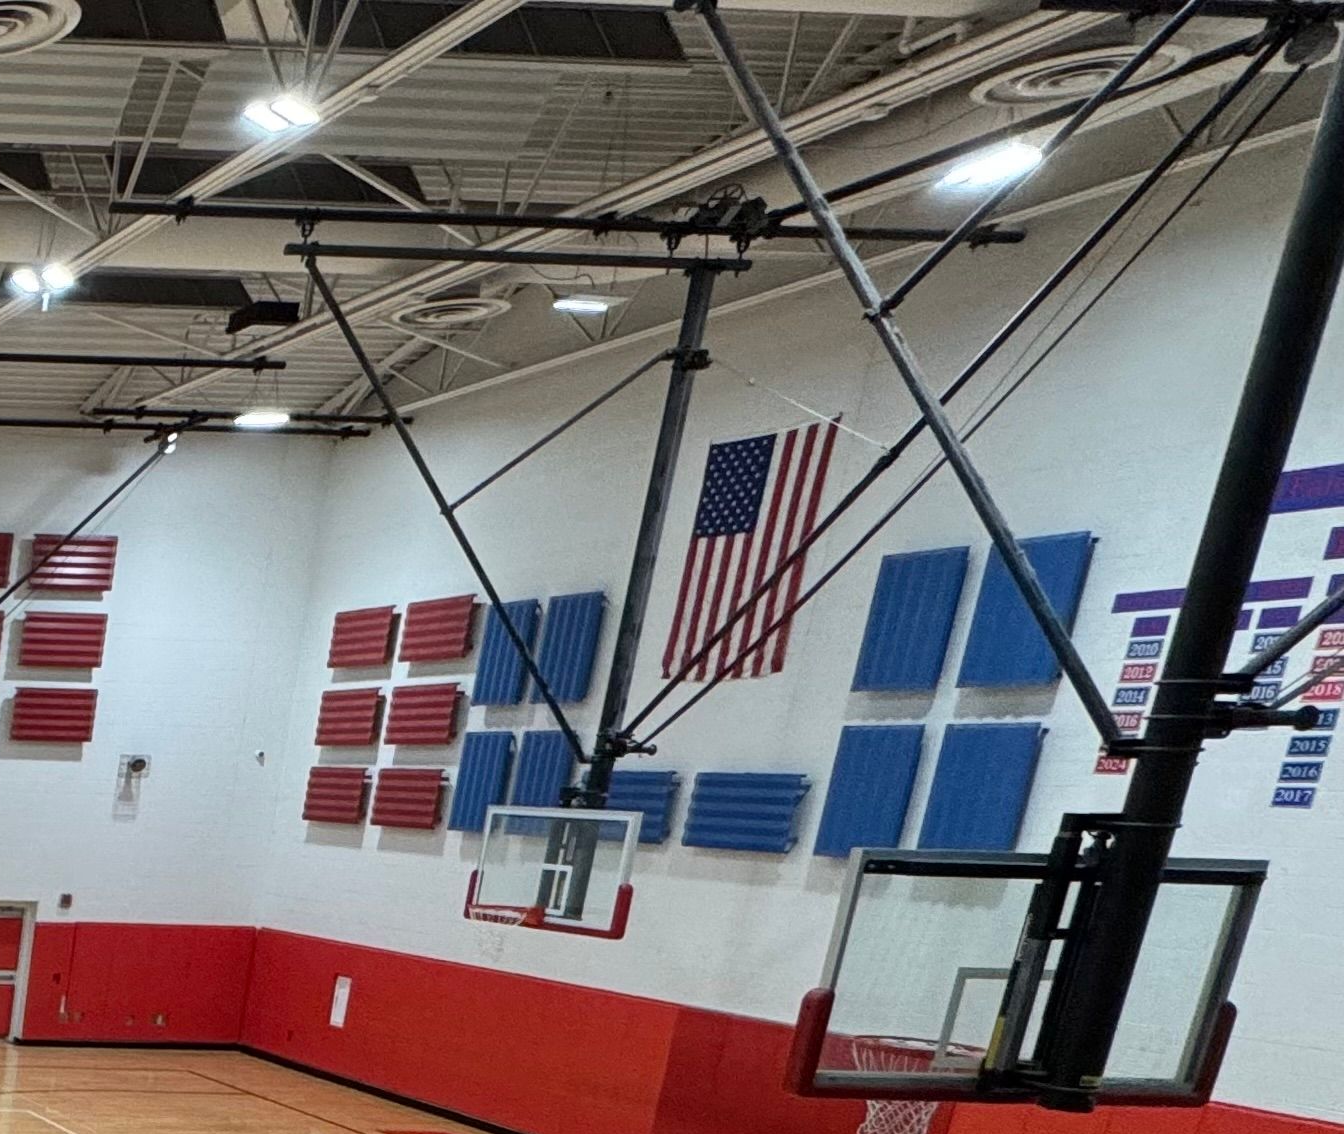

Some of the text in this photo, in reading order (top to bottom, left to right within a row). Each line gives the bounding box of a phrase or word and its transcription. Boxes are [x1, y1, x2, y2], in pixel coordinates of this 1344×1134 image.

[1123, 666, 1153, 679] 2012
[1291, 740, 1328, 753] 2015
[1282, 766, 1318, 778] 2016
[1275, 789, 1312, 802] 2017
